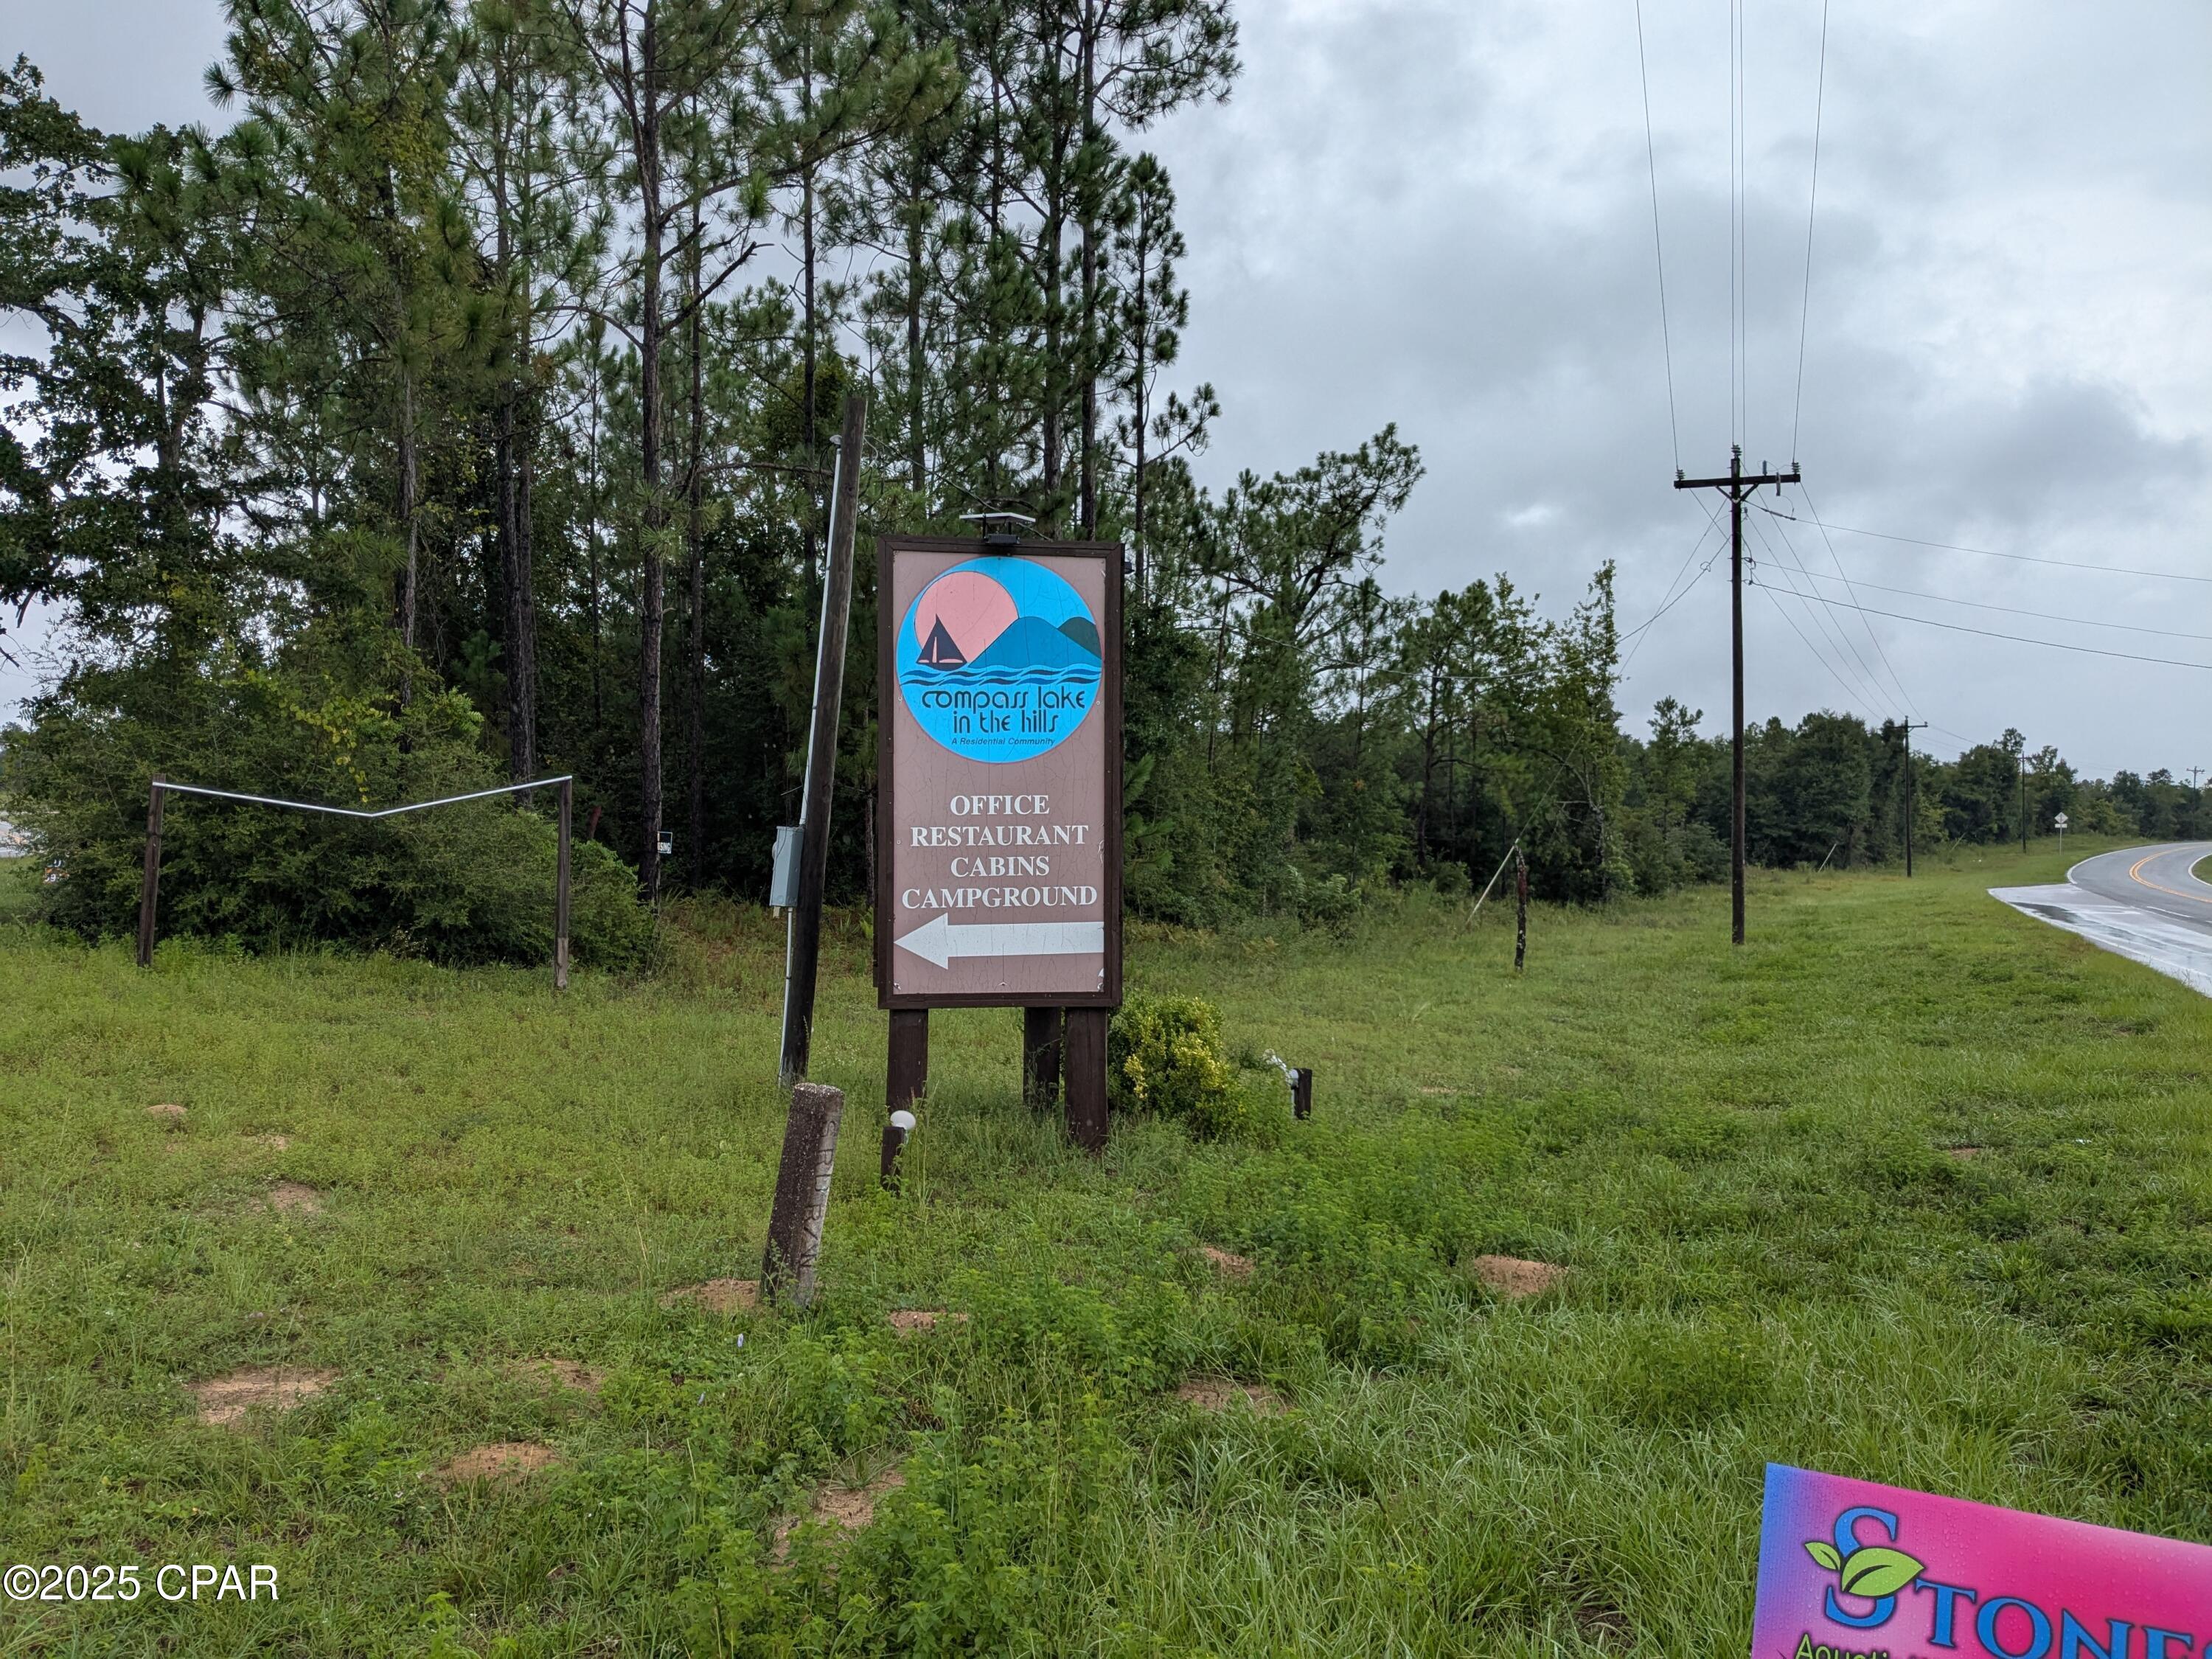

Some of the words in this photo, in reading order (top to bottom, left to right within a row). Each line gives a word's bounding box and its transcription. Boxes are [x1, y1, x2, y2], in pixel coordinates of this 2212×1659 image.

[922, 690, 1029, 714] compass
[1038, 686, 1085, 709] lake
[953, 710, 970, 734] in
[979, 710, 1011, 733] the
[1021, 709, 1059, 732] hills
[1008, 737, 1056, 747] Community
[950, 795, 1050, 815] OFFICE
[910, 825, 1089, 846] RESTAURANT
[950, 856, 1050, 877] CABINS
[902, 886, 1098, 909] CAMPGROUND
[1825, 1506, 2212, 1659] STON
